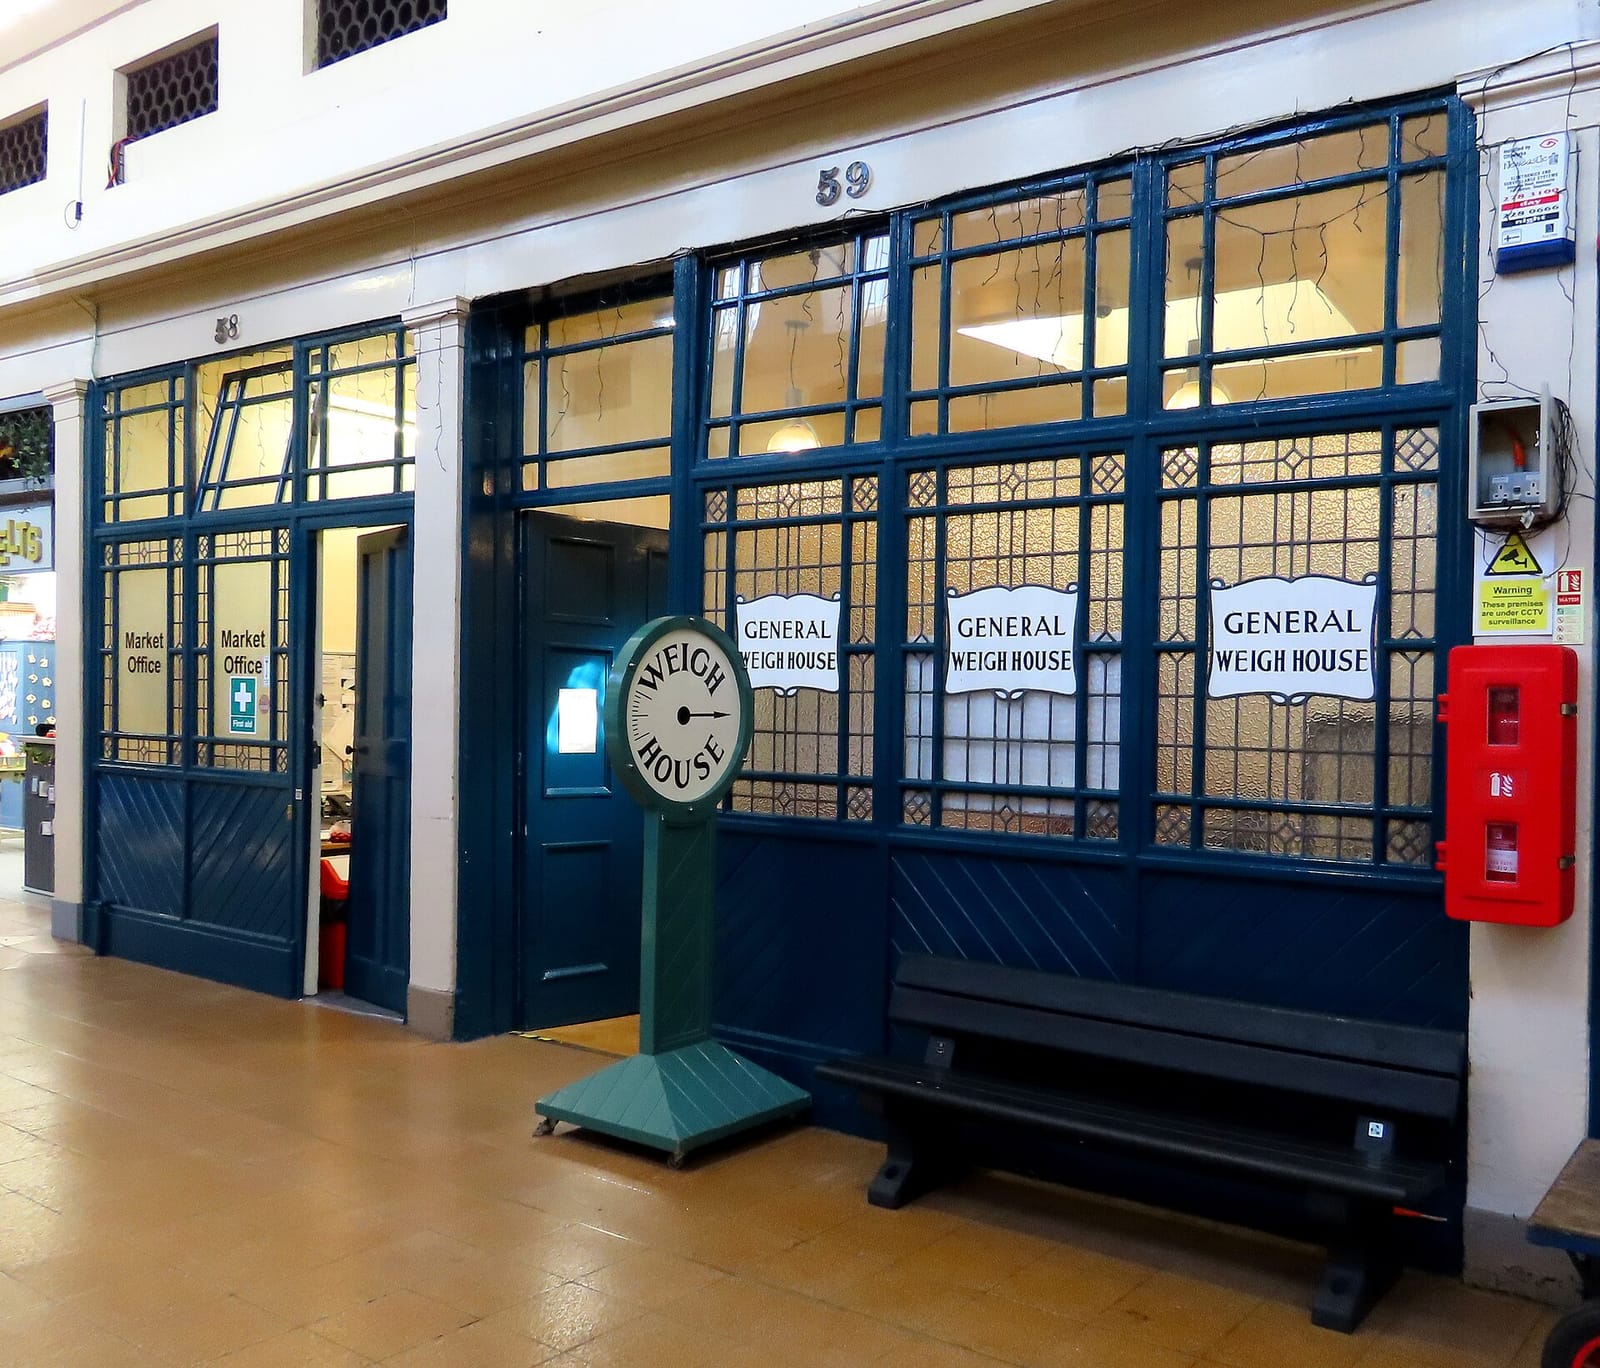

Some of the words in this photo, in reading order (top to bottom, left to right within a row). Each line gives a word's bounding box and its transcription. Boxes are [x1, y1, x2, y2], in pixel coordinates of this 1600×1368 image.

[816, 161, 870, 206] 59
[1519, 198, 1542, 207] day
[1514, 214, 1546, 224] night
[214, 313, 240, 344] 58
[1493, 586, 1533, 595] Warning
[744, 620, 831, 639] GENERAL
[957, 615, 1066, 638] GENERAL
[1224, 610, 1362, 634] GENERAL
[125, 632, 164, 649] Market
[221, 630, 266, 648] Market
[127, 656, 161, 673] Office
[224, 656, 262, 674] Office
[638, 643, 725, 696] WEIGH
[740, 651, 784, 669] WEIGH
[787, 651, 836, 670] HOUSE
[951, 651, 1008, 672] WEIGH
[1012, 650, 1072, 671] HOUSE
[1216, 649, 1285, 672] WEIGH
[1292, 649, 1369, 672] HOUSE
[232, 719, 244, 727] First
[244, 720, 253, 728] aid
[638, 734, 725, 788] HOUSE
